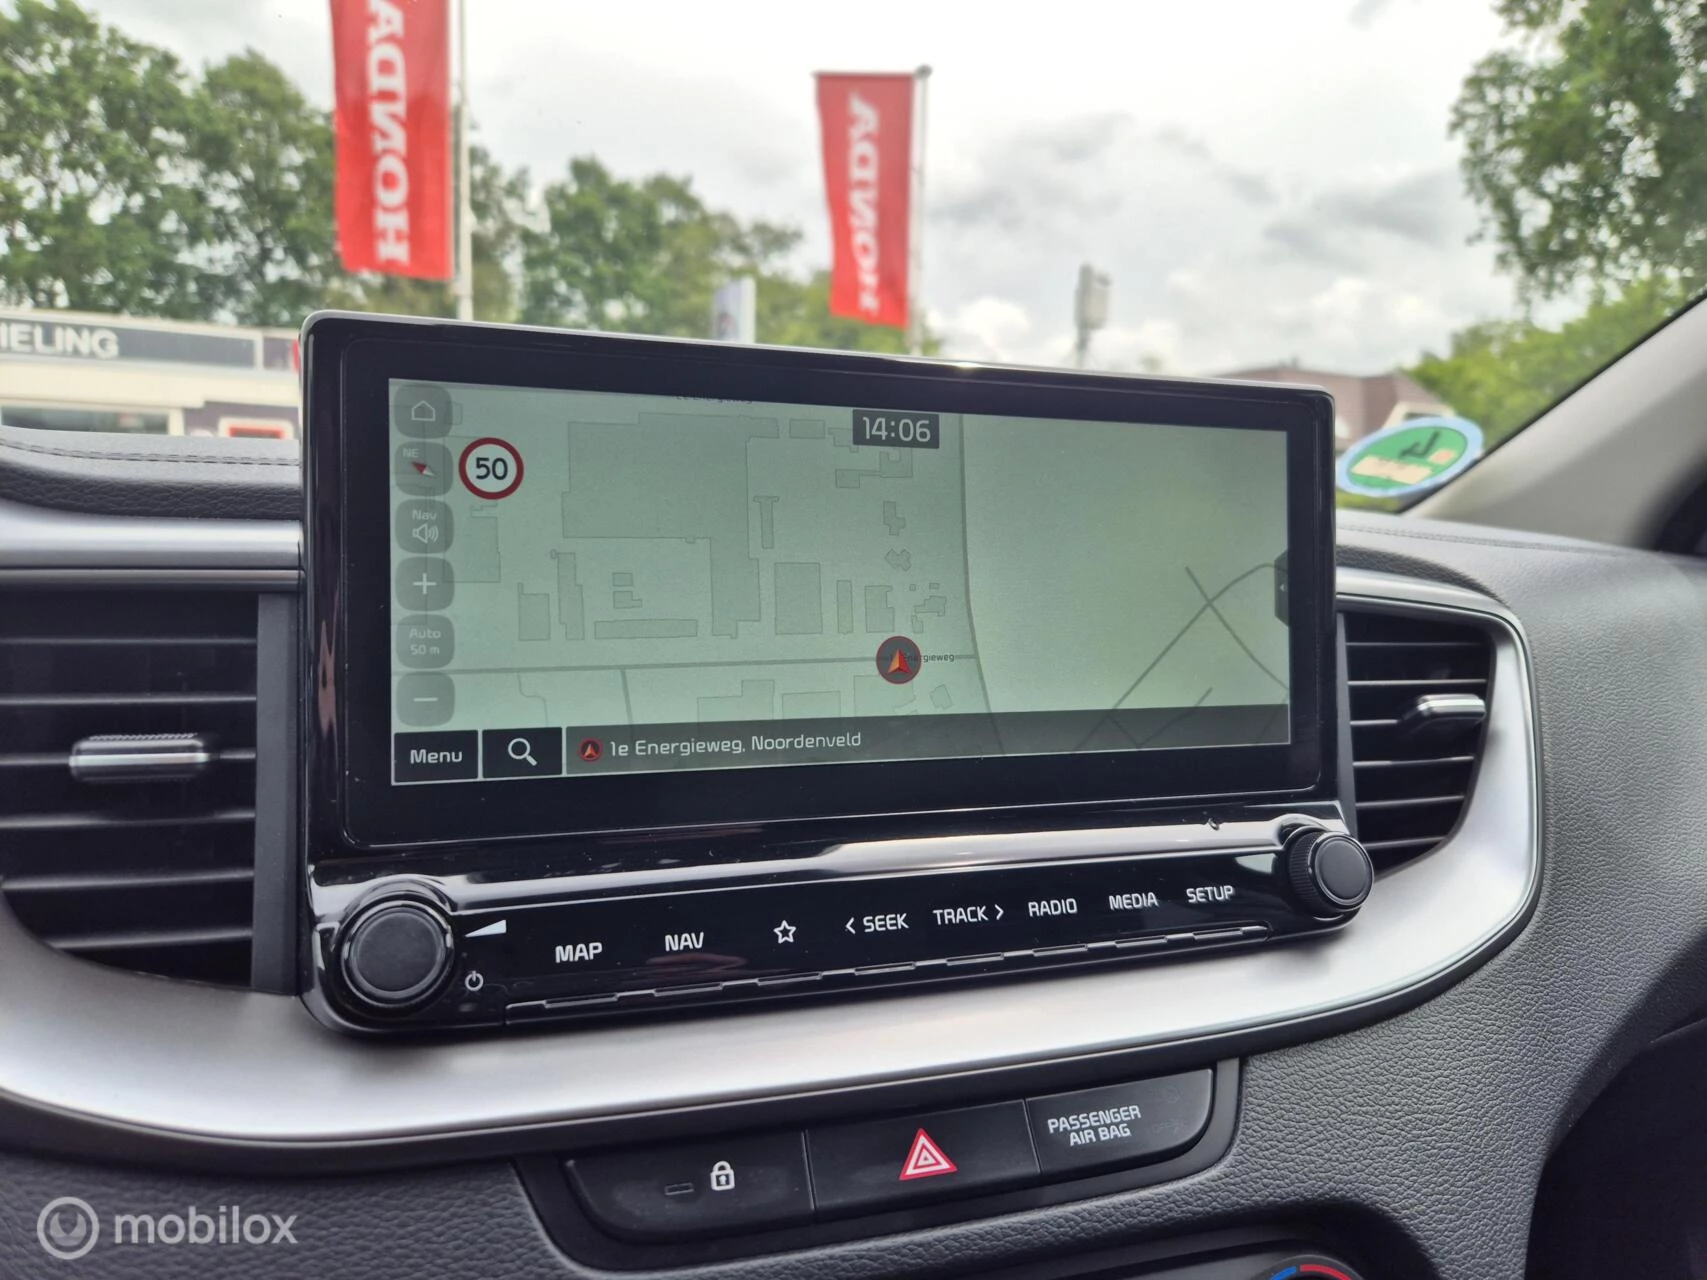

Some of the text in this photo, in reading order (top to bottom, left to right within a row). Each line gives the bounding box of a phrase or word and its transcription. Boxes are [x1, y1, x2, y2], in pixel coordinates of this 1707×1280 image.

[862, 416, 931, 443] 14:06
[475, 457, 508, 480] 50
[412, 509, 437, 521] Nav
[409, 628, 442, 639] Auto
[411, 645, 425, 656] 50
[610, 741, 629, 757] 1e
[752, 732, 861, 750] Noordenveld
[410, 748, 463, 765] Menu
[1109, 891, 1160, 911] MEDIA
[1186, 885, 1234, 904] SETUP
[933, 905, 989, 926] TRACK
[1028, 897, 1078, 918] RADIO
[863, 913, 909, 933] SEEK
[665, 931, 704, 952] NAV
[555, 942, 603, 964] MAP
[1047, 1105, 1141, 1134] PASSENGER
[1069, 1123, 1131, 1146] AIR BAG
